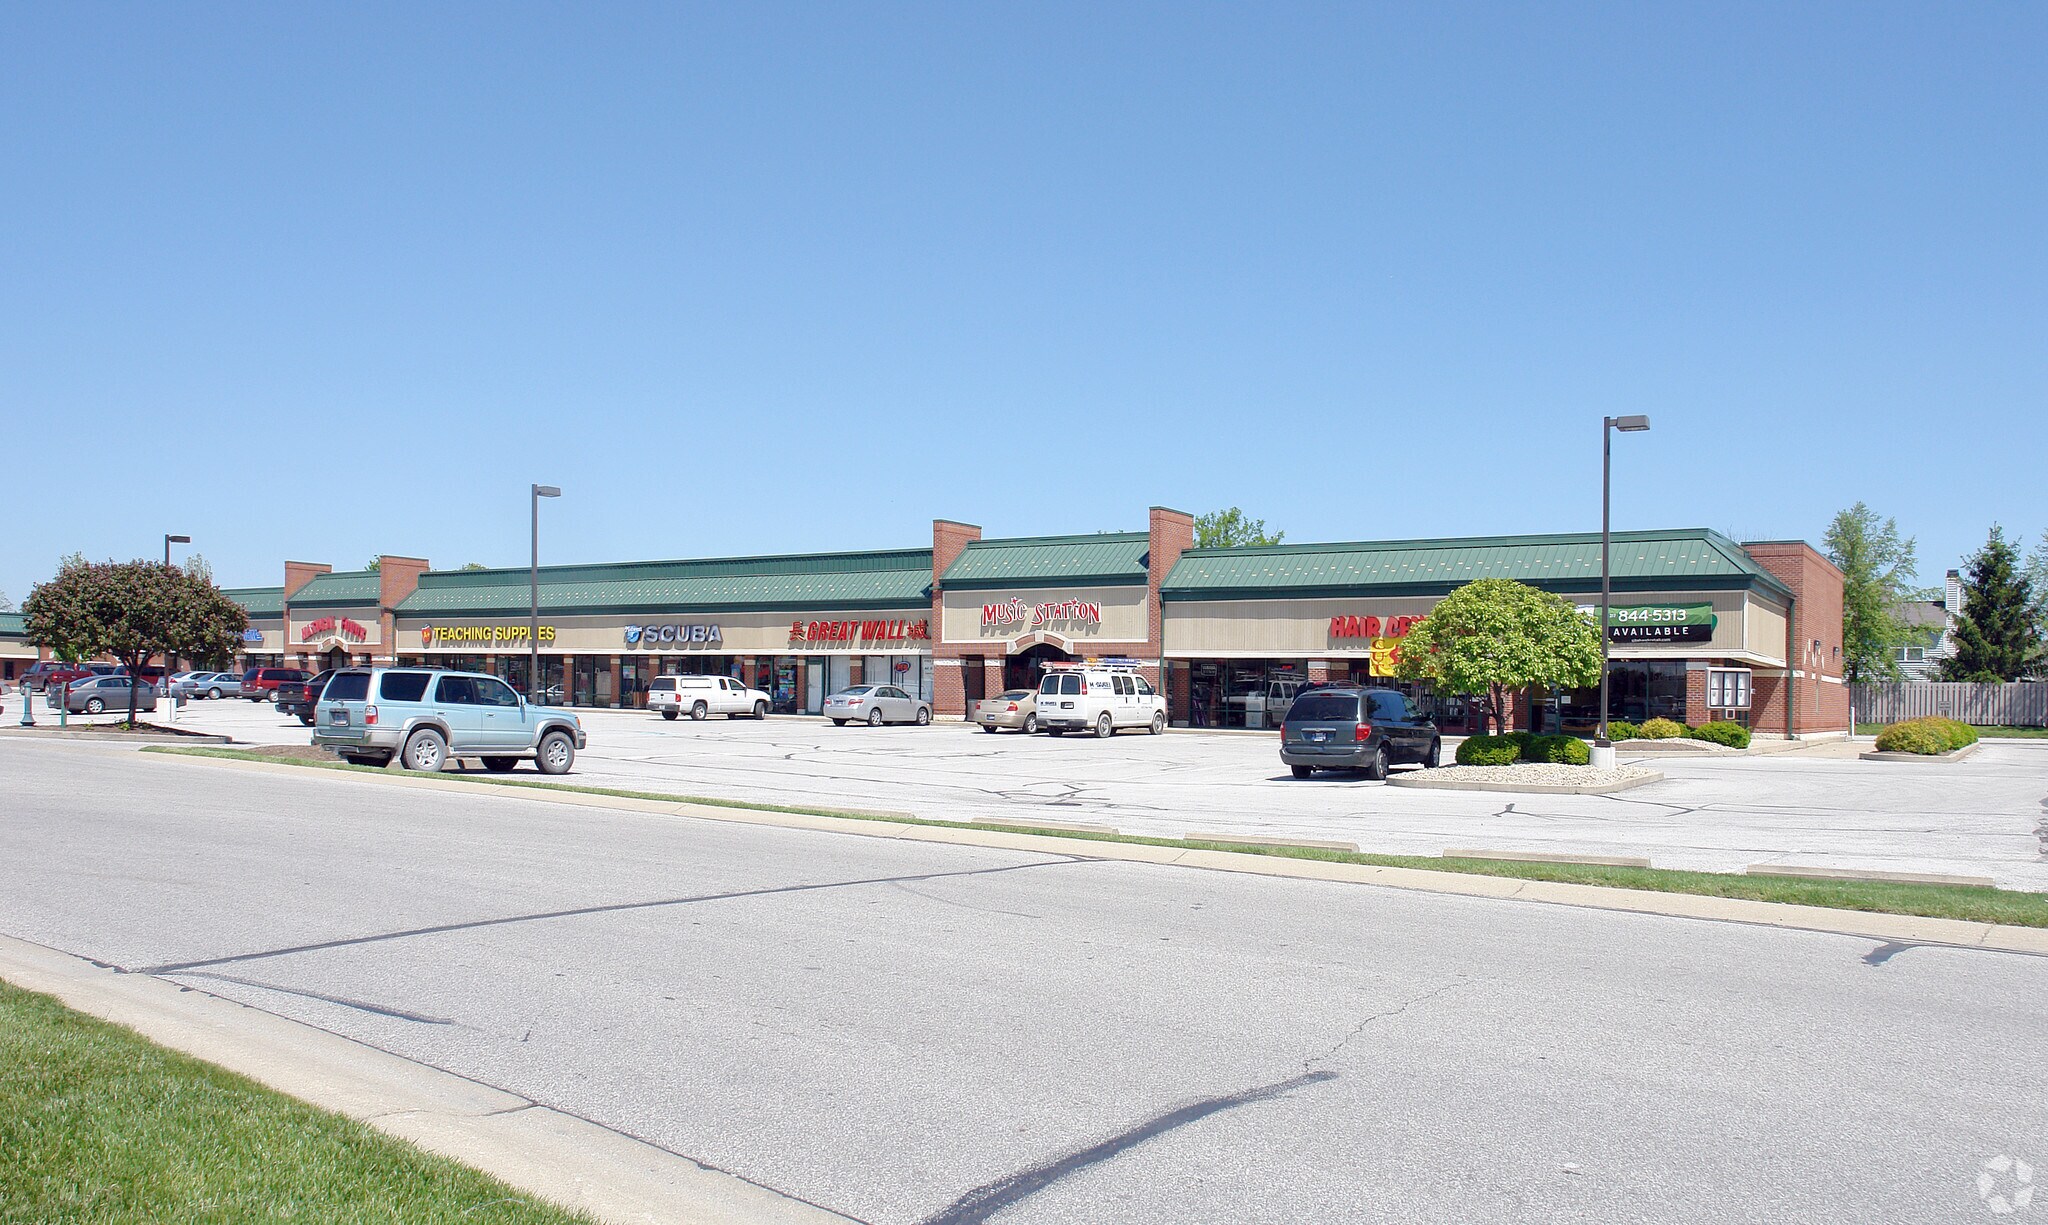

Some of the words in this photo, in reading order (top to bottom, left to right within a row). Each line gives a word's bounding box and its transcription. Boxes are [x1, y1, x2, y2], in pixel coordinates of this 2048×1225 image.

[1618, 608, 1688, 622] 844-5313
[433, 626, 492, 641] TEACHING
[495, 626, 556, 641] SUPPLES
[643, 624, 724, 643] SCUBA
[807, 620, 858, 641] GREAT
[861, 618, 906, 640] WALL
[1331, 615, 1381, 638] HAIR
[1613, 626, 1690, 636] AVAILABLE
